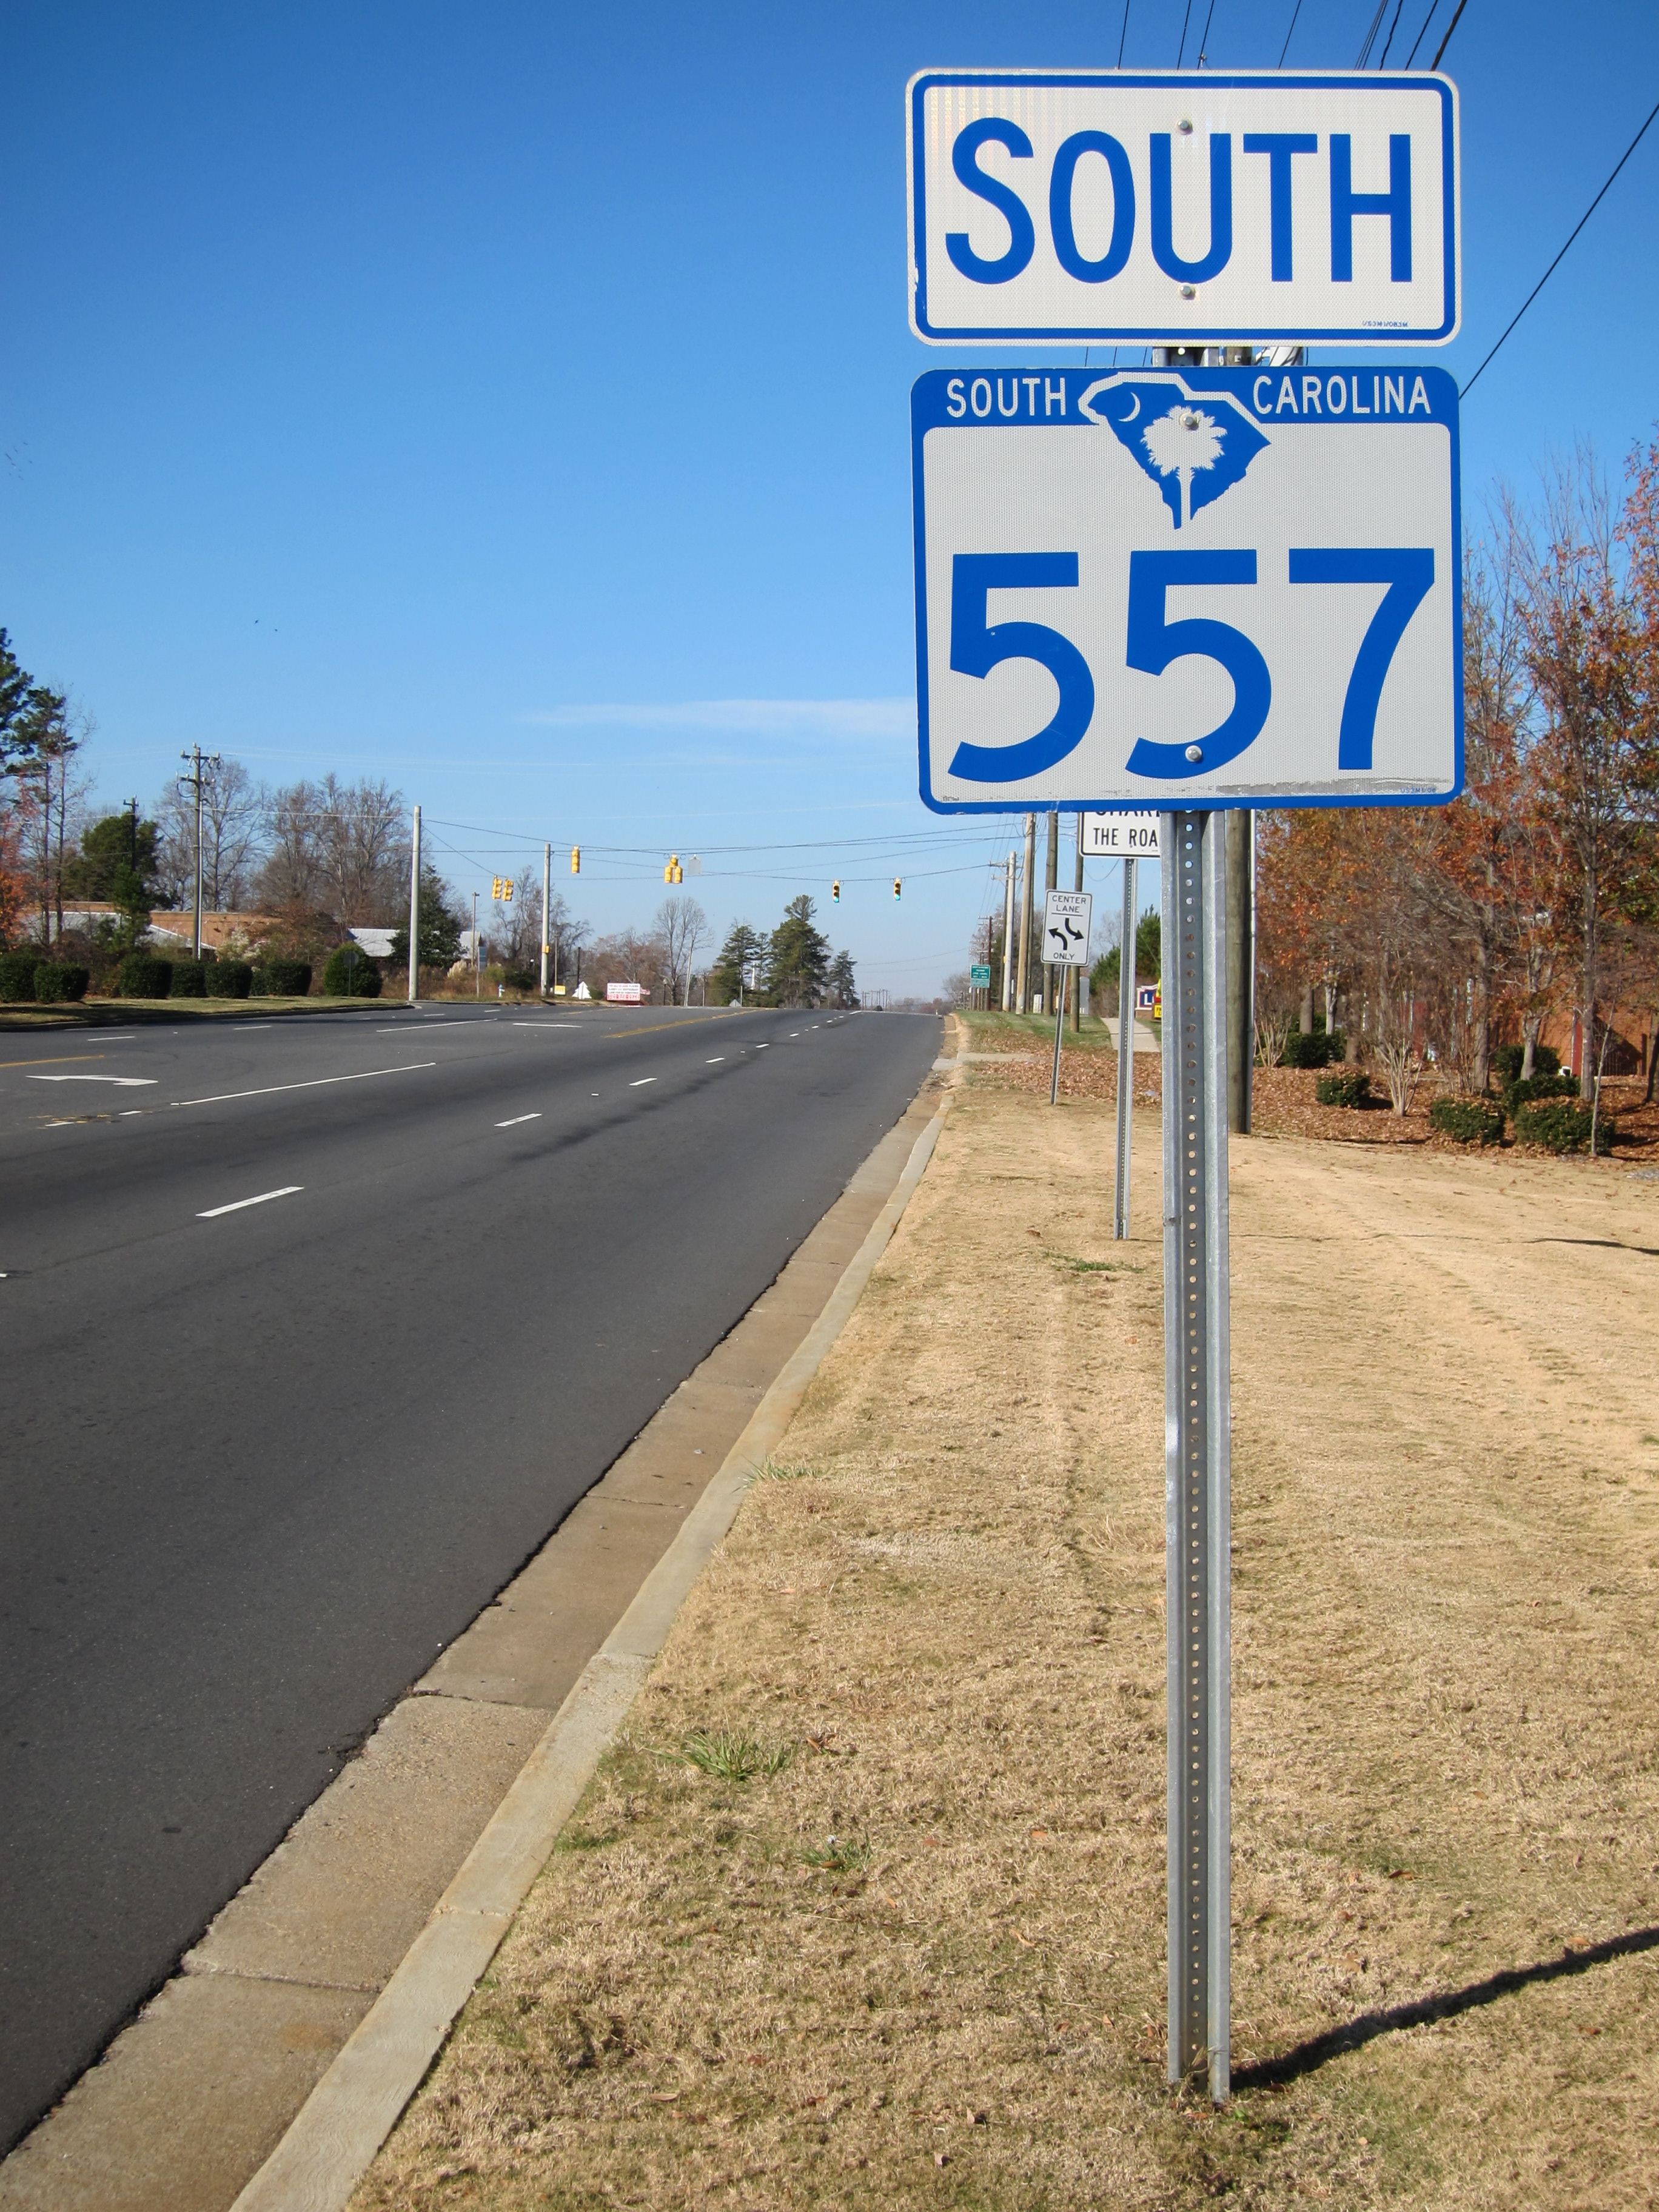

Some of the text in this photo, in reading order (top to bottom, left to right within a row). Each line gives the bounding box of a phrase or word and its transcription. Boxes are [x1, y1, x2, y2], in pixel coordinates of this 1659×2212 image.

[946, 117, 1412, 284] SOUTH
[947, 375, 1431, 418] SOUTH CAROLINA
[948, 548, 1435, 783] 557
[1093, 828, 1158, 847] THE ROA
[1052, 894, 1087, 904] CENTER
[1056, 905, 1080, 913] LANE
[1053, 952, 1075, 960] ONLY
